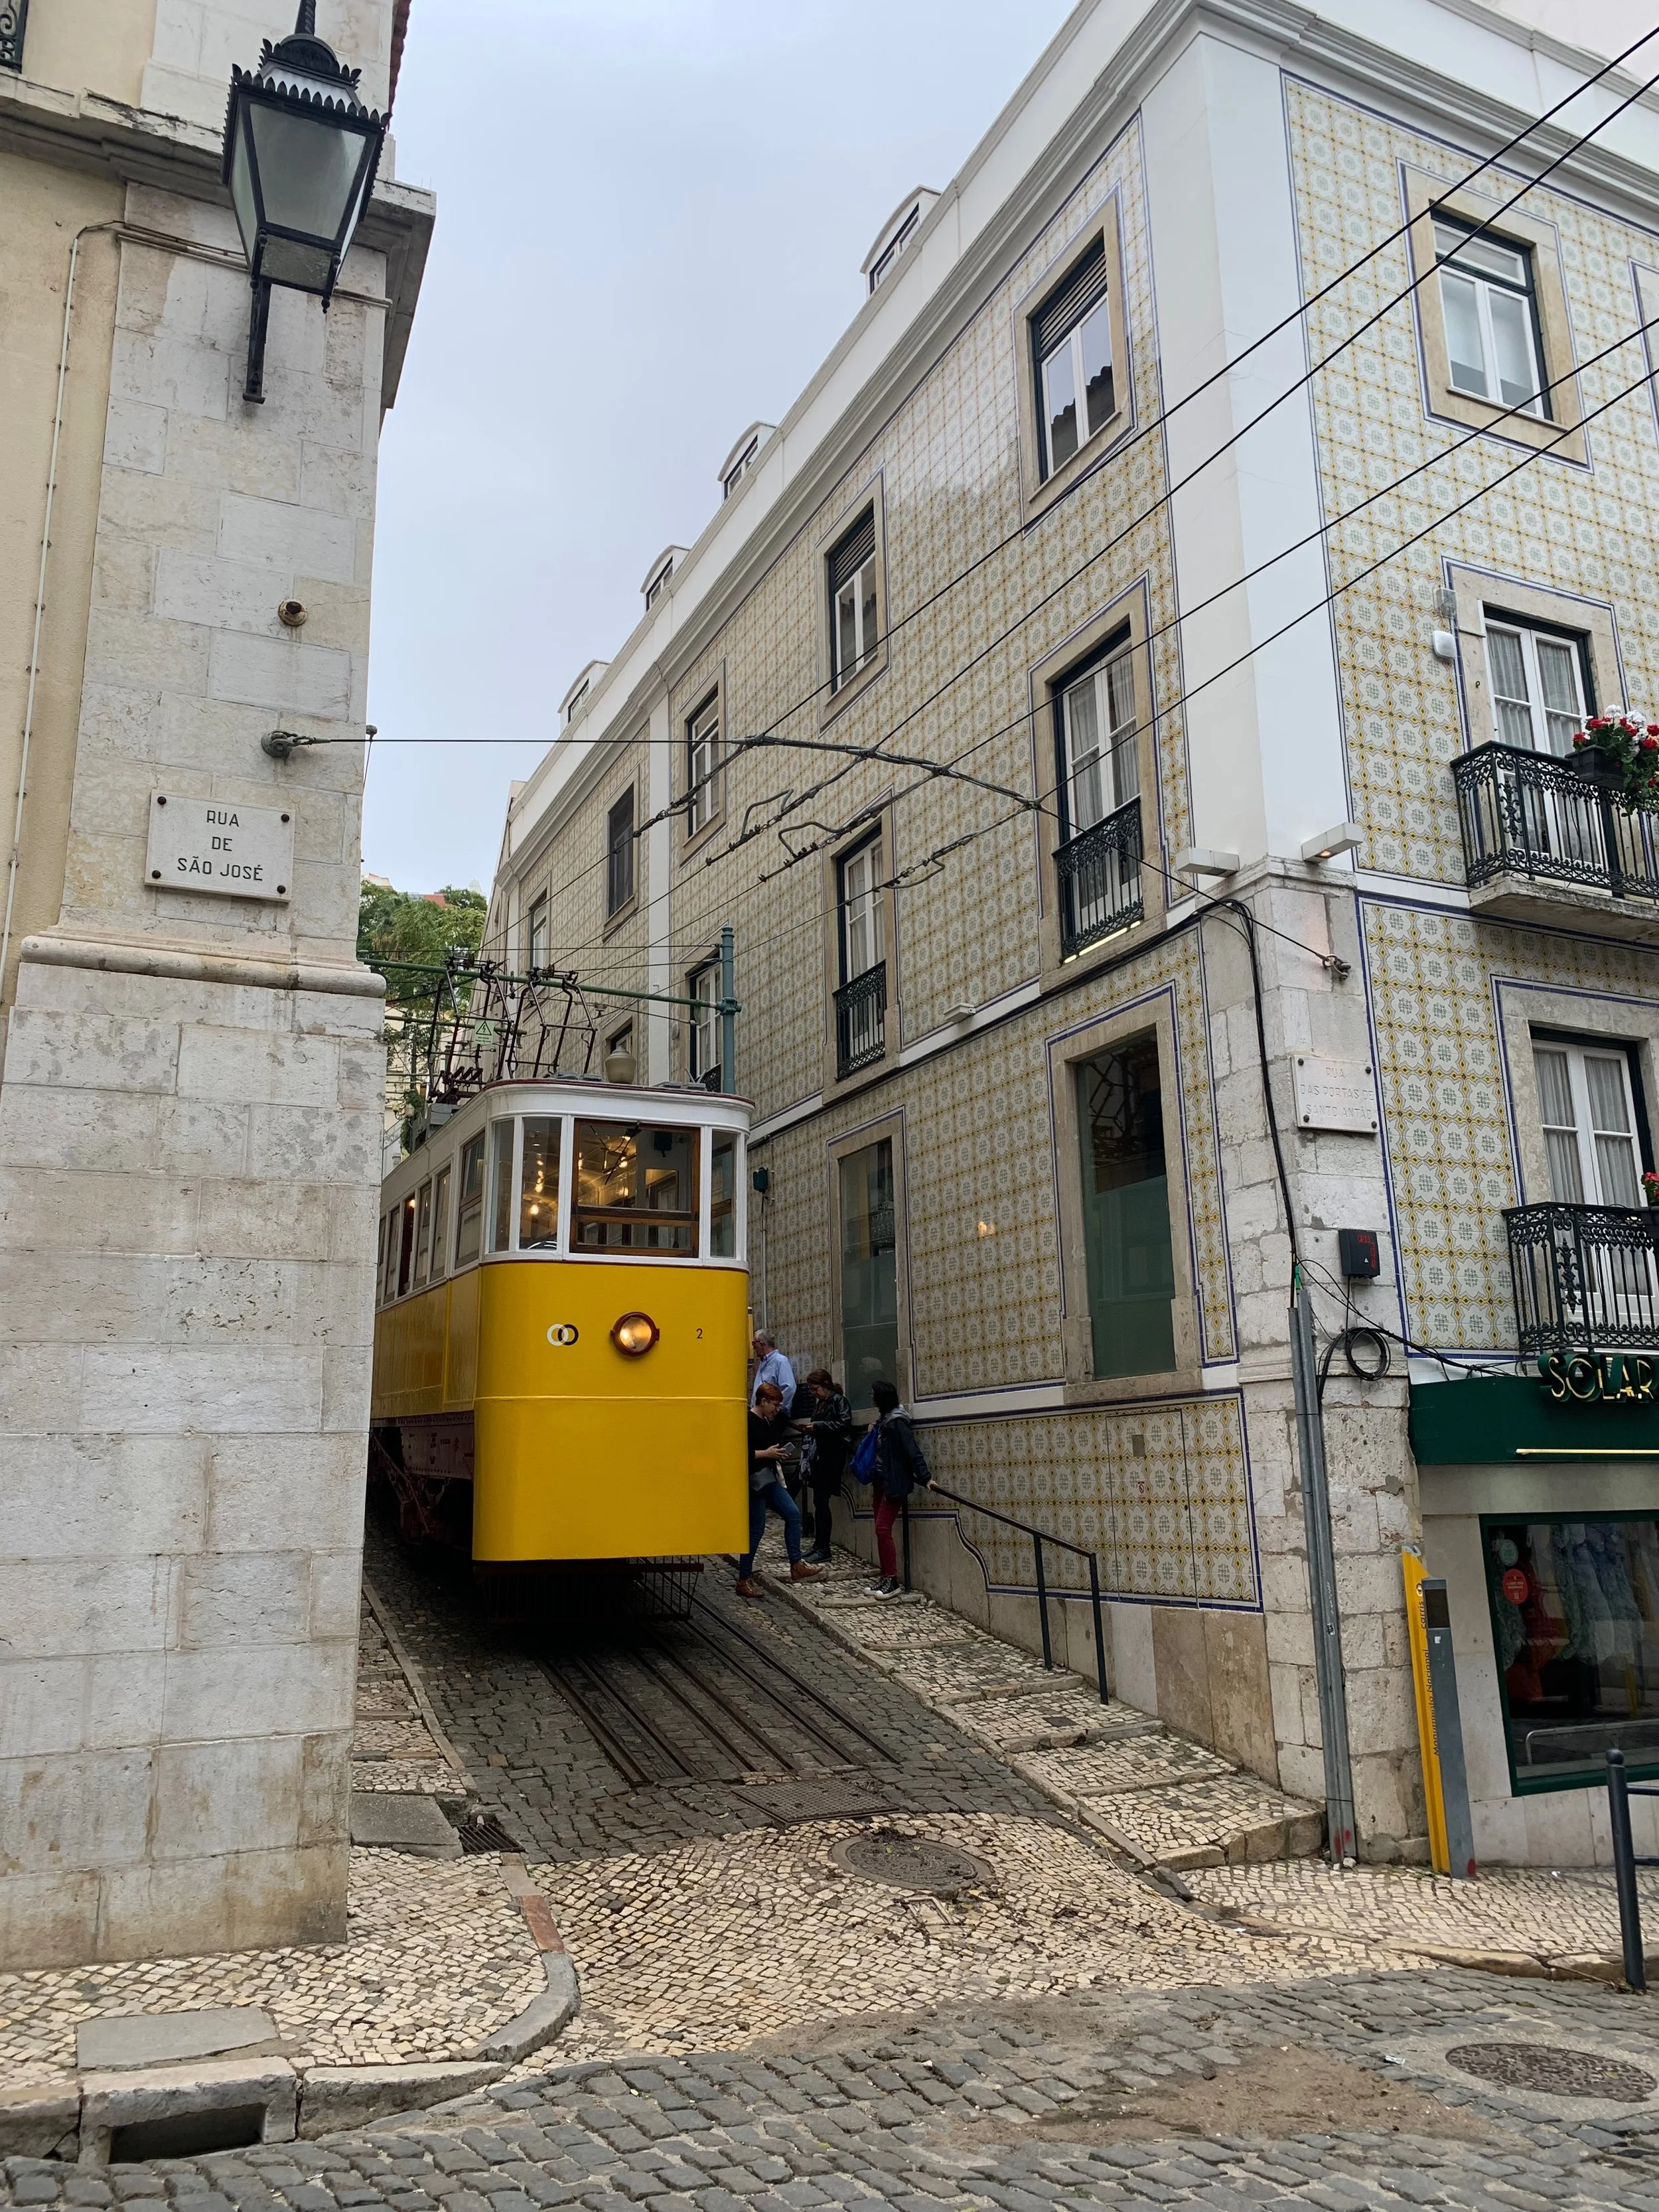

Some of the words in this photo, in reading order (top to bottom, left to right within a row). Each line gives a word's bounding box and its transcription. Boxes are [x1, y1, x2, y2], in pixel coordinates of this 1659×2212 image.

[206, 810, 240, 827] RUA
[211, 836, 232, 851] DE
[177, 855, 212, 875] SÃO
[220, 864, 263, 881] JOSÉ
[1326, 1067, 1346, 1078] RUA
[1300, 1084, 1320, 1096] DAS
[1323, 1086, 1360, 1100] PORTAS
[1362, 1090, 1374, 1101] DE
[1306, 1104, 1338, 1117] SANTO
[1342, 1106, 1372, 1120] ANTÃO
[696, 1328, 703, 1339] 2
[1540, 1353, 1658, 1401] SOLAR
[1417, 1601, 1426, 1629] carris
[1423, 1649, 1433, 1692] Nacional
